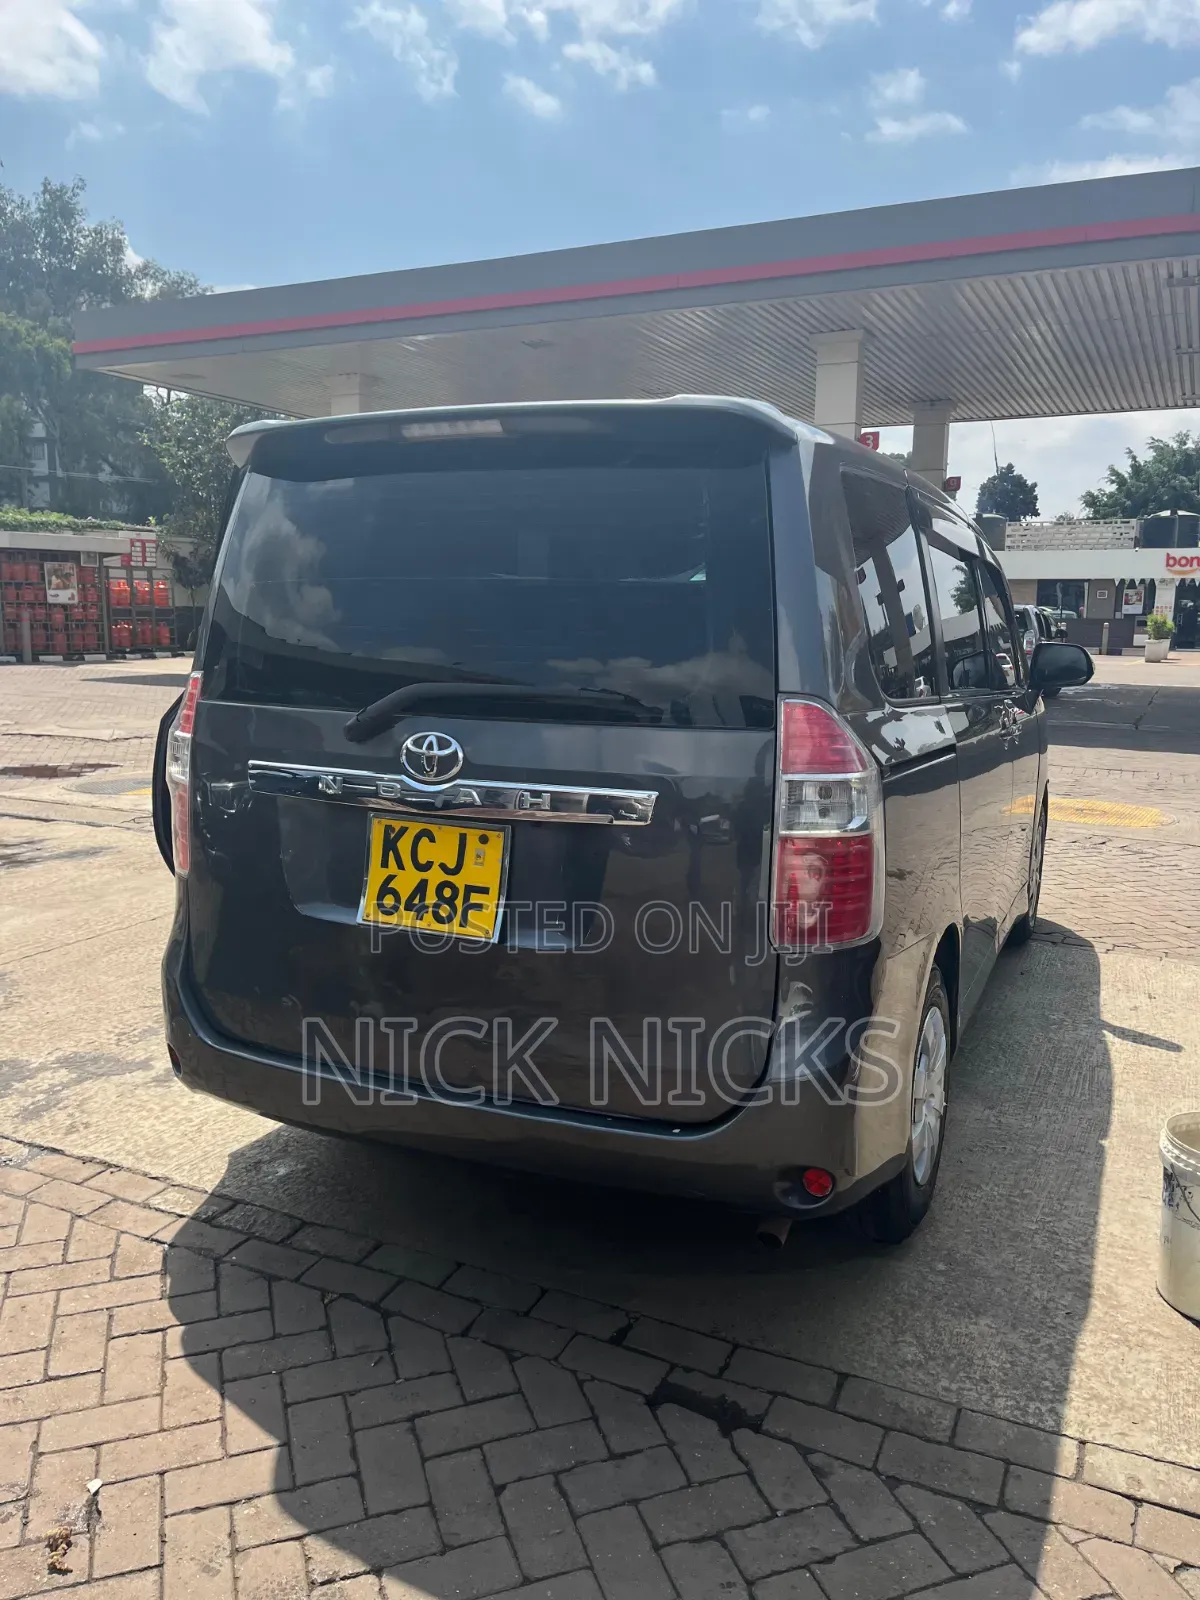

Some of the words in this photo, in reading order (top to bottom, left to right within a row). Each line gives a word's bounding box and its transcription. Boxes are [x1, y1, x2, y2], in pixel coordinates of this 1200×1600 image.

[865, 434, 874, 450] 3
[380, 824, 468, 876] KCJ
[376, 874, 491, 928] 648F
